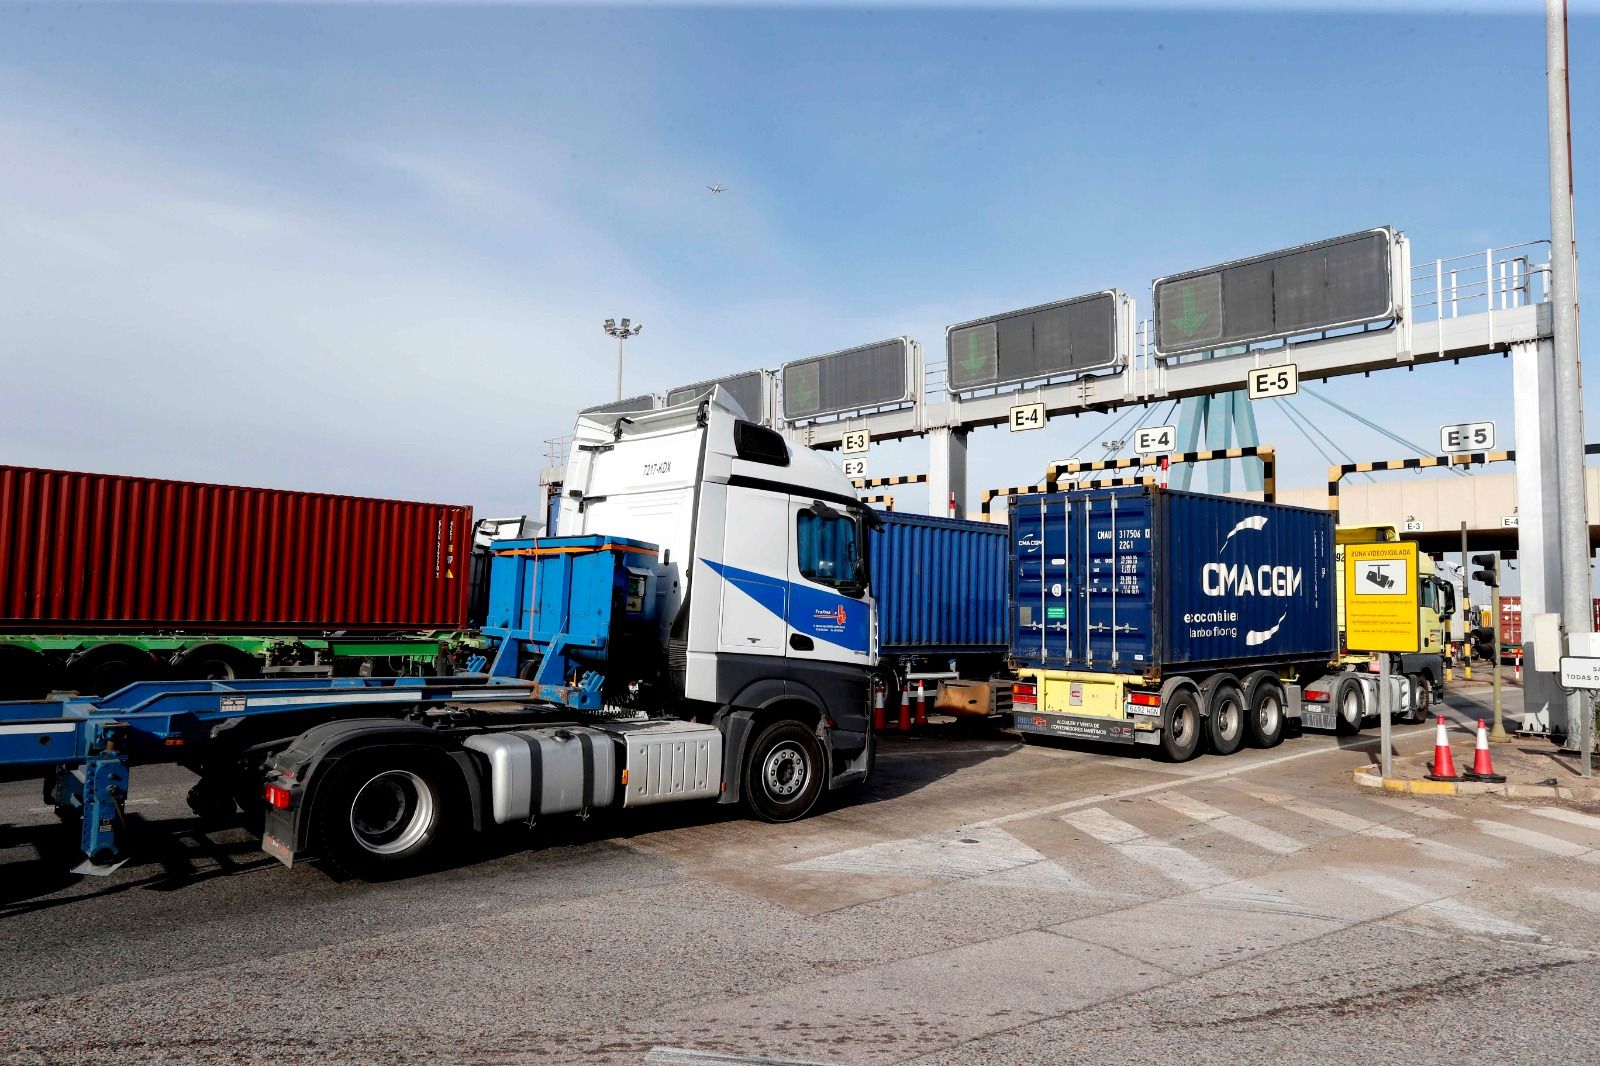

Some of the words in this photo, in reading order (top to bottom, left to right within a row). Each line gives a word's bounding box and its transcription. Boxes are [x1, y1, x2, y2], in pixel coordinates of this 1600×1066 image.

[1256, 372, 1288, 393] E-5
[1015, 408, 1038, 426] E-4
[846, 435, 864, 449] E-3
[1139, 431, 1170, 448] E-4
[1447, 429, 1488, 446] E-5
[643, 461, 671, 476] 7217-KDX
[845, 462, 863, 474] E-2
[1097, 530, 1112, 539] CMAU
[1119, 530, 1141, 539] 317506
[1119, 541, 1134, 550] 22G1
[1202, 562, 1255, 597] CMA
[1257, 564, 1302, 597] CGM
[1502, 604, 1521, 612] ZIM
[1567, 673, 1592, 681] TODAS
